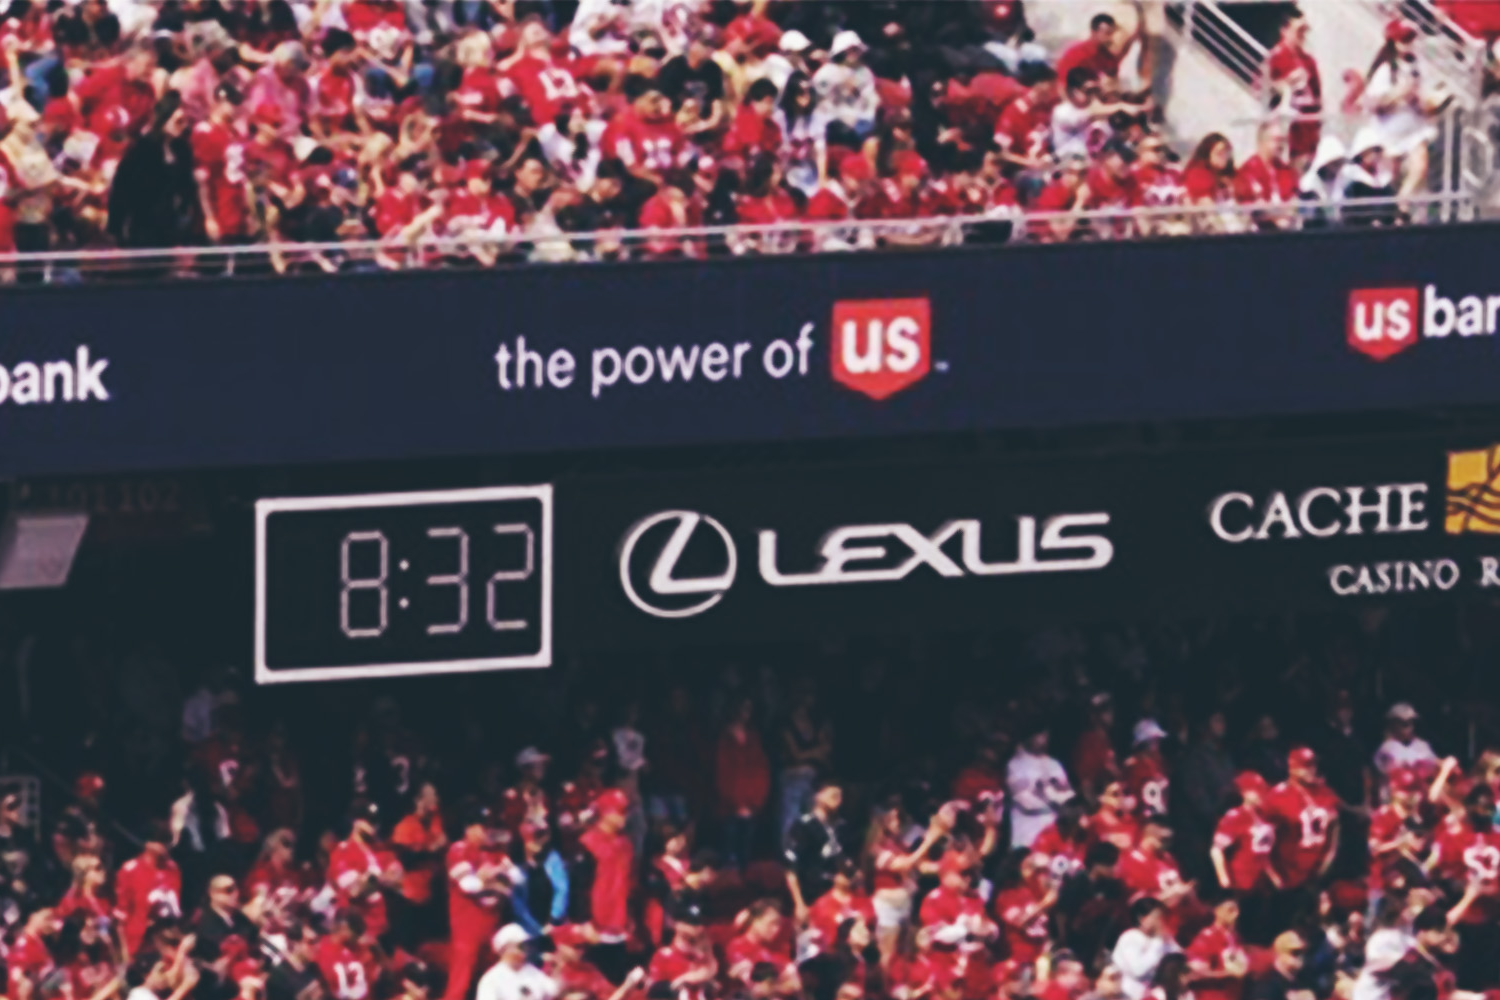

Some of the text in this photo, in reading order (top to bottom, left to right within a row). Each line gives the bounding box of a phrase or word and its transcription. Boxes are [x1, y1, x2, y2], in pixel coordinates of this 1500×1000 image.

[1353, 297, 1411, 342] us
[493, 315, 921, 398] the power of us
[1209, 482, 1429, 542] CACHE
[340, 522, 536, 639] 8:32
[757, 511, 1115, 587] LEXUS
[1329, 559, 1461, 595] CASINO
